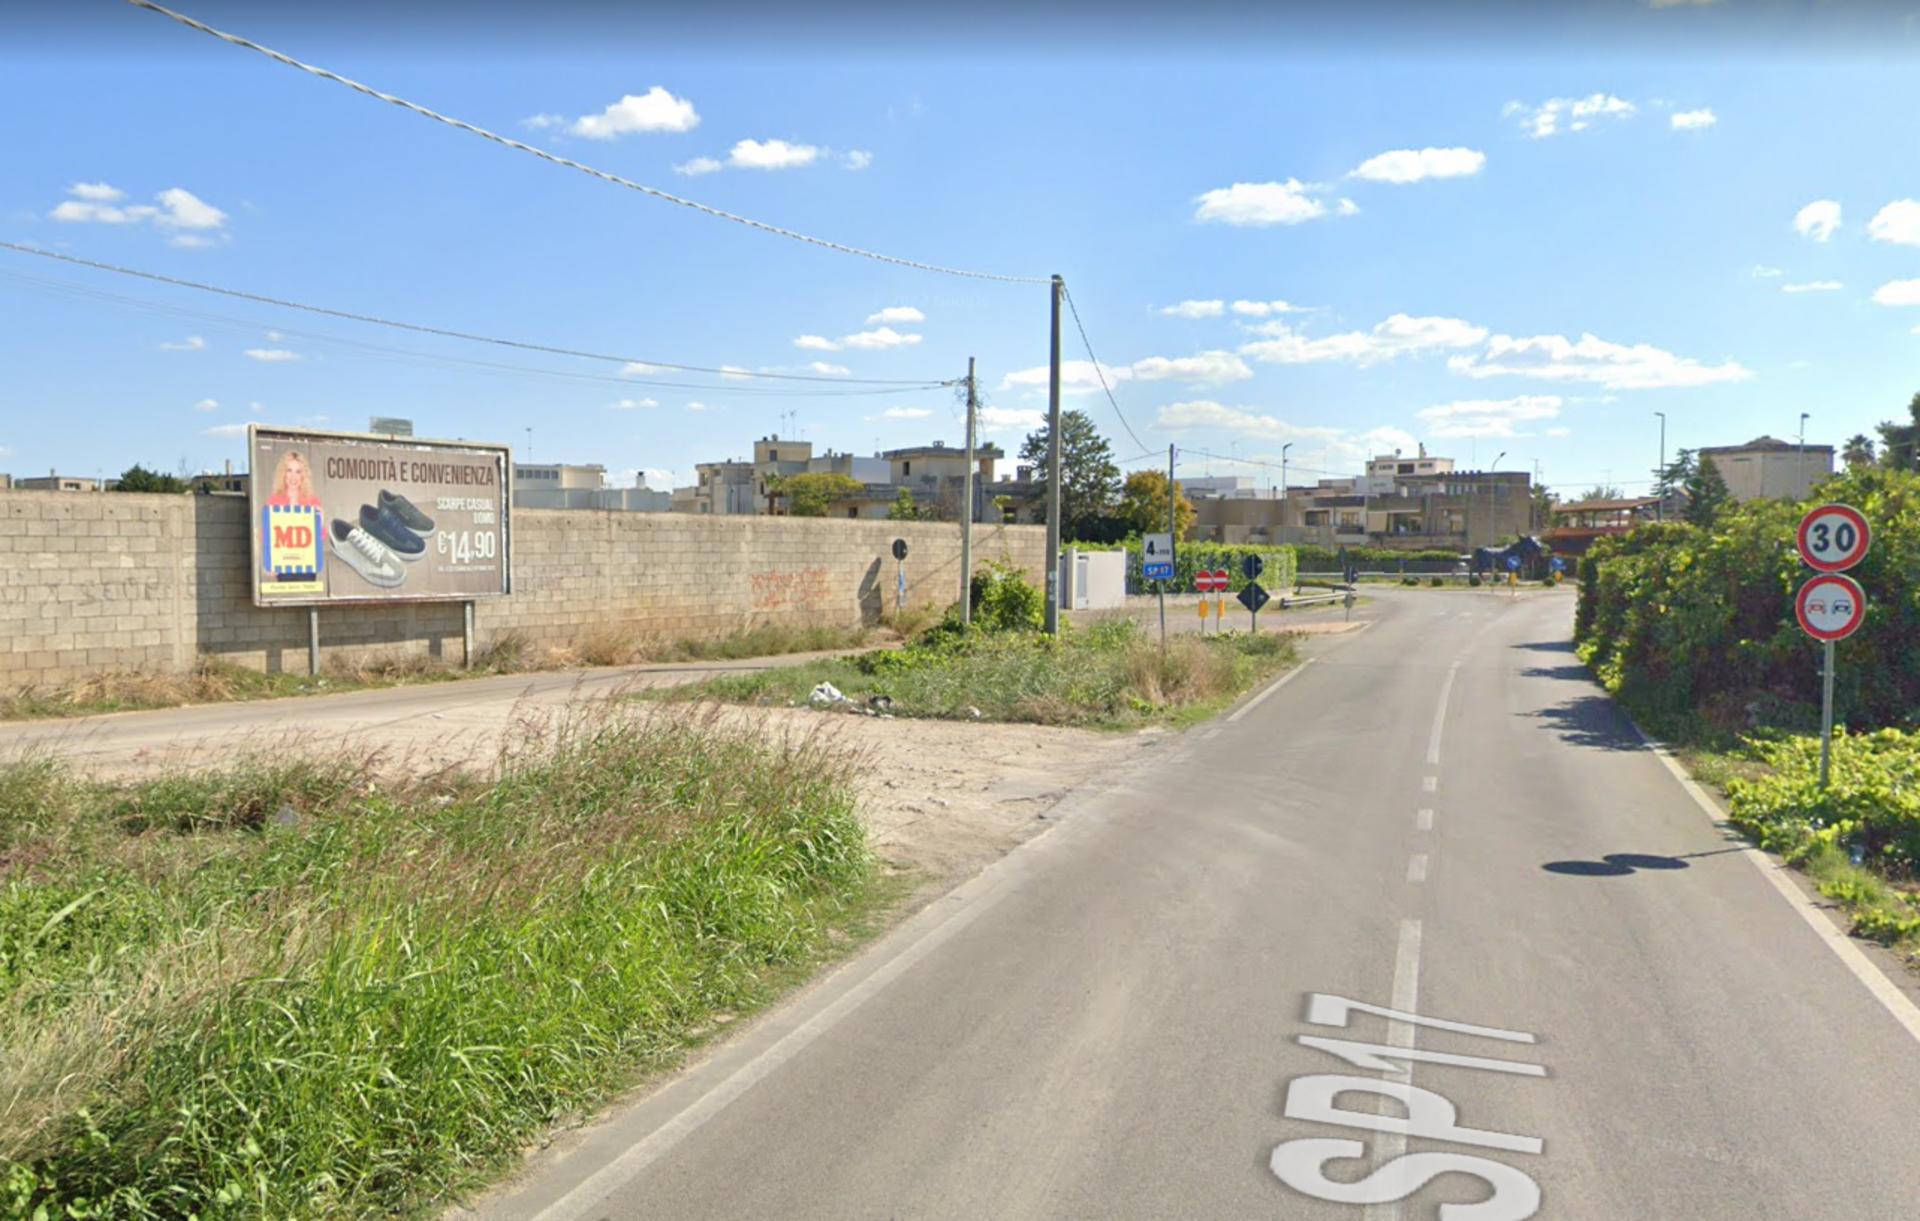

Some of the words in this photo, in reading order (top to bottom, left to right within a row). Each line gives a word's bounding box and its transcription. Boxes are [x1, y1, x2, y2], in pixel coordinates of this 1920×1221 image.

[327, 456, 397, 482] COMODITÀ
[400, 461, 408, 482] E
[411, 461, 494, 486] CONVENIENZA
[273, 525, 313, 548] MD
[1812, 522, 1856, 552] 30
